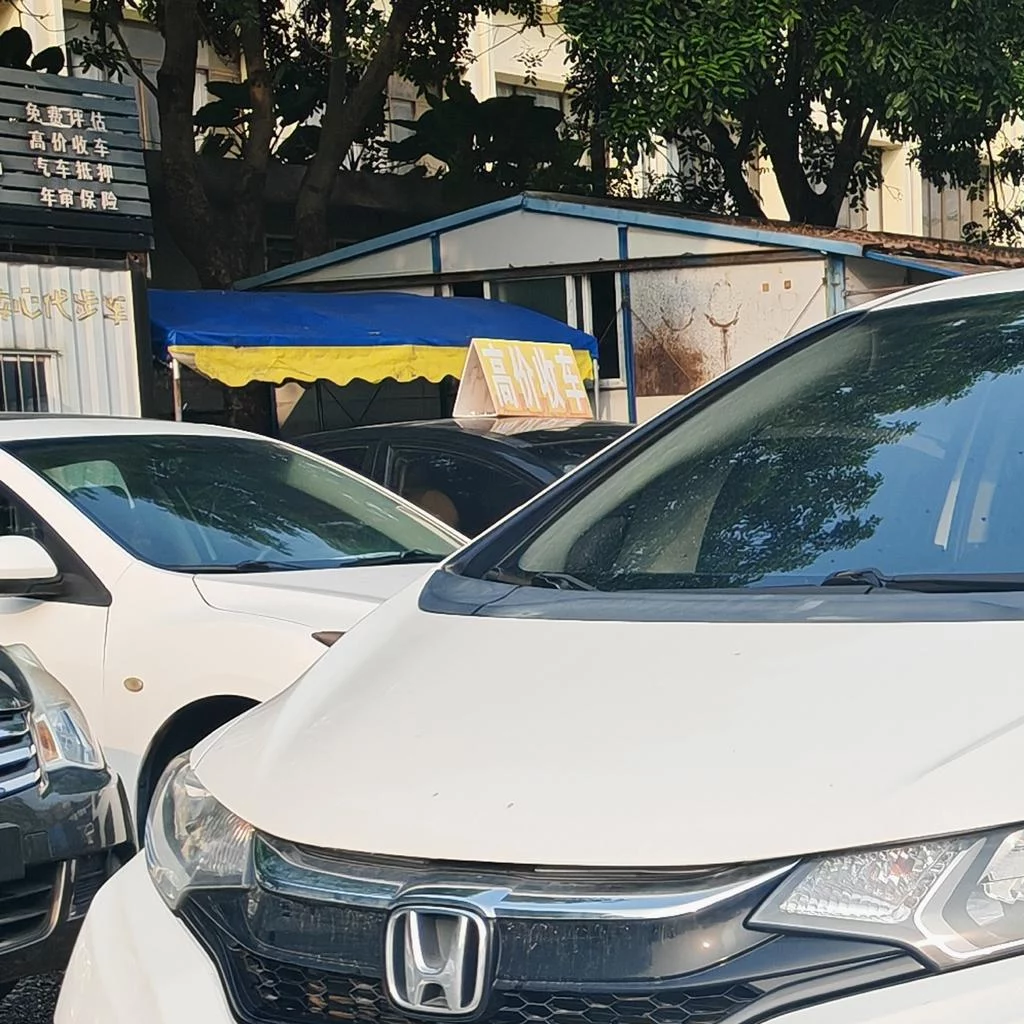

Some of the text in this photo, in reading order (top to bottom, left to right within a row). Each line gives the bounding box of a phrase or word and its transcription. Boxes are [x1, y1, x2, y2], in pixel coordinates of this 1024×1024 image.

[25, 103, 107, 132] 免费评估
[28, 130, 110, 158] 高价收车
[33, 157, 114, 183] 汽车抵押
[40, 186, 119, 211] 年审保险
[482, 343, 584, 412] 高价收车
